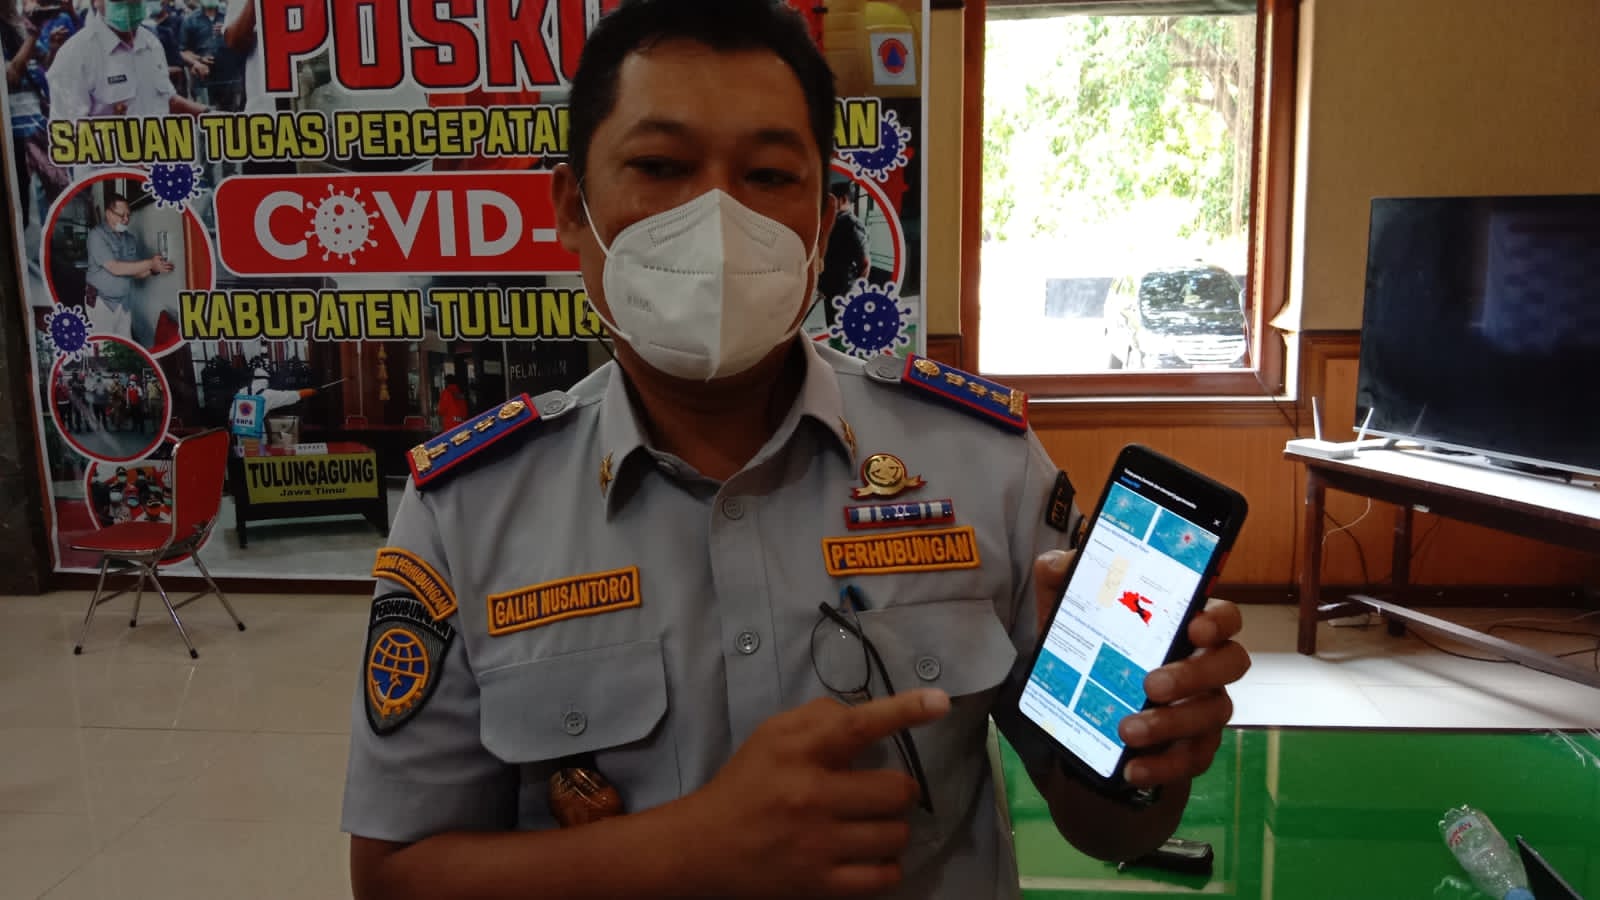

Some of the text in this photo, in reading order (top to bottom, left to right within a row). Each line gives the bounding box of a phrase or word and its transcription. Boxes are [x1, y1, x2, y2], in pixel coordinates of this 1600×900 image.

[49, 116, 194, 165] SATUAN
[202, 113, 326, 160] TUGAS
[181, 289, 610, 340] KABUPATEN TULUNG
[248, 459, 374, 488] TULUNGAGUNG
[280, 487, 347, 497] Jawa Timur
[831, 533, 971, 568] PERHUBUNGAN
[495, 575, 630, 624] GALIH NUSANTORO
